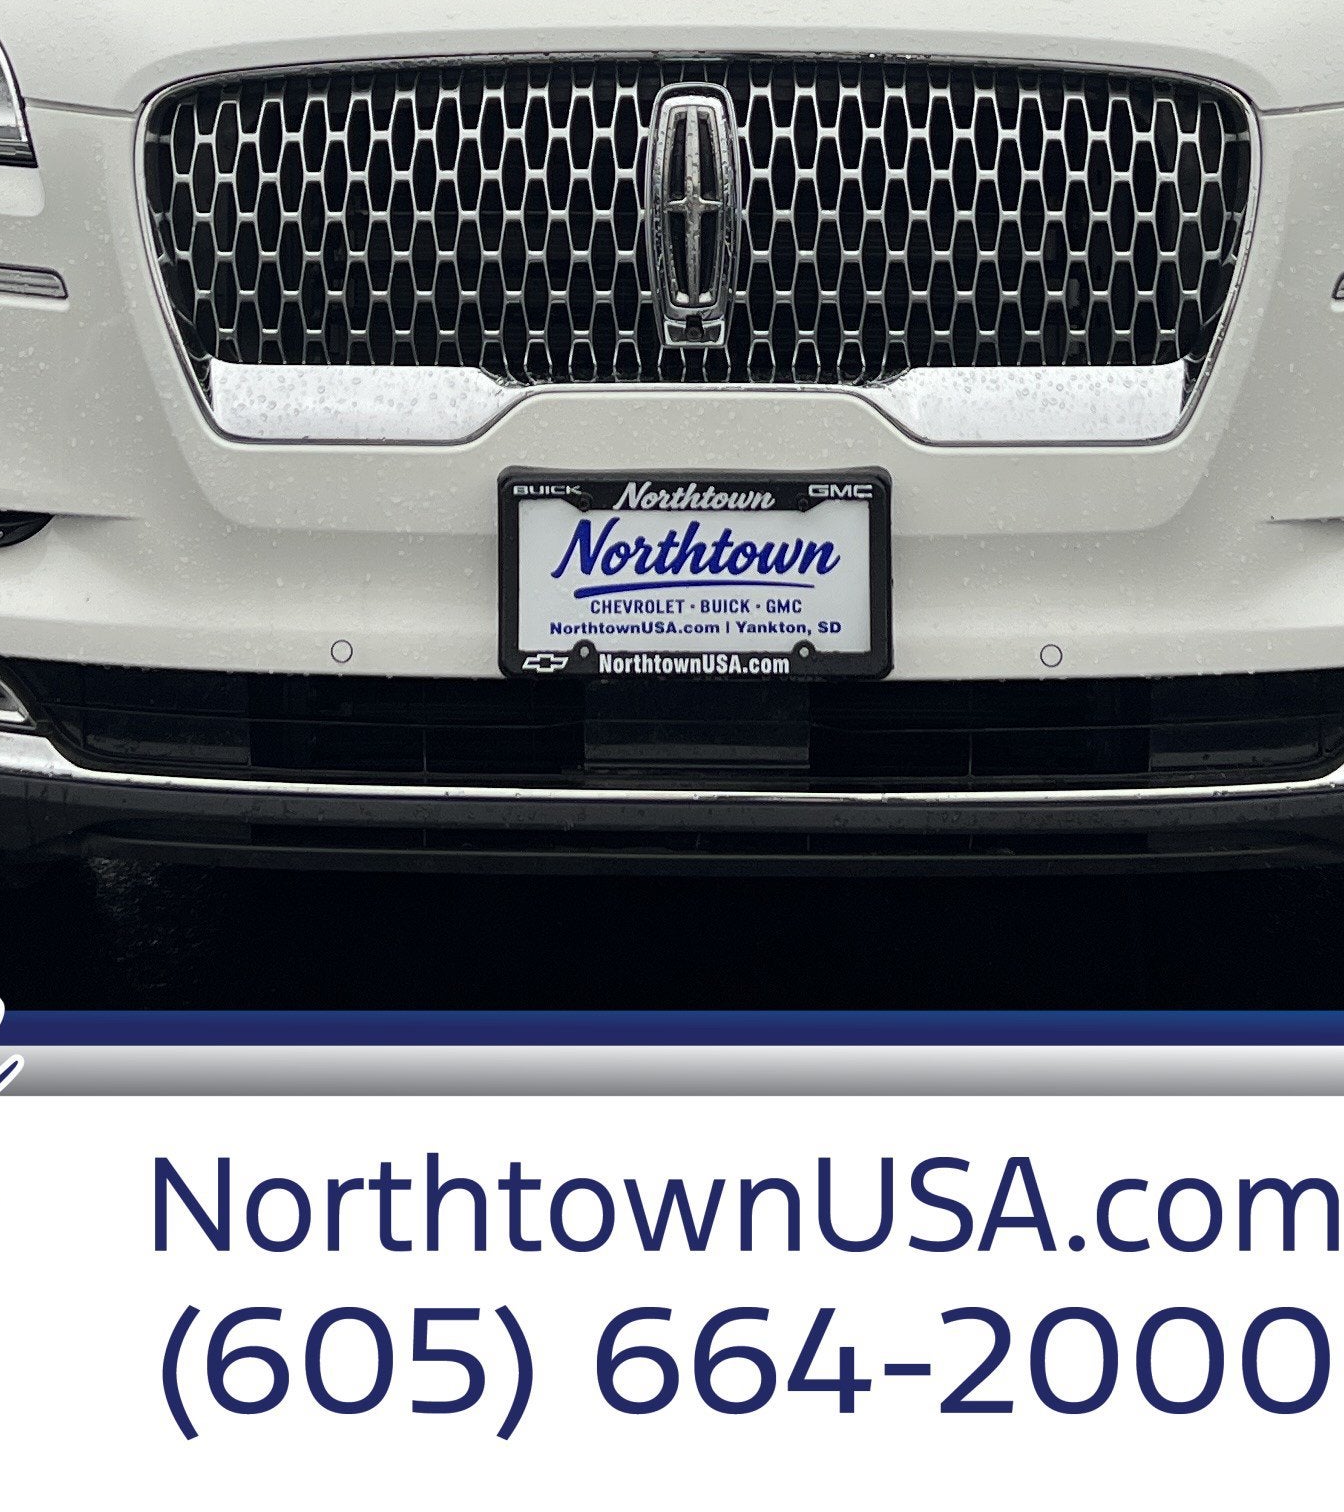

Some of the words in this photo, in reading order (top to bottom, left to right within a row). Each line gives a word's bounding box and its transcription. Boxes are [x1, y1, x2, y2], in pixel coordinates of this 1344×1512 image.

[513, 485, 582, 496] BUICK
[612, 481, 775, 511] Northtown
[808, 484, 873, 499] GMC
[551, 517, 840, 578] Northtown
[590, 599, 685, 614] CHEVROLET
[700, 599, 750, 614] BUICK
[766, 599, 802, 614] GMC
[550, 620, 720, 635] NorthtownUSA.com
[736, 620, 812, 636] Yankton,
[818, 620, 842, 634] SD
[599, 654, 790, 674] NorthtownUSA.com
